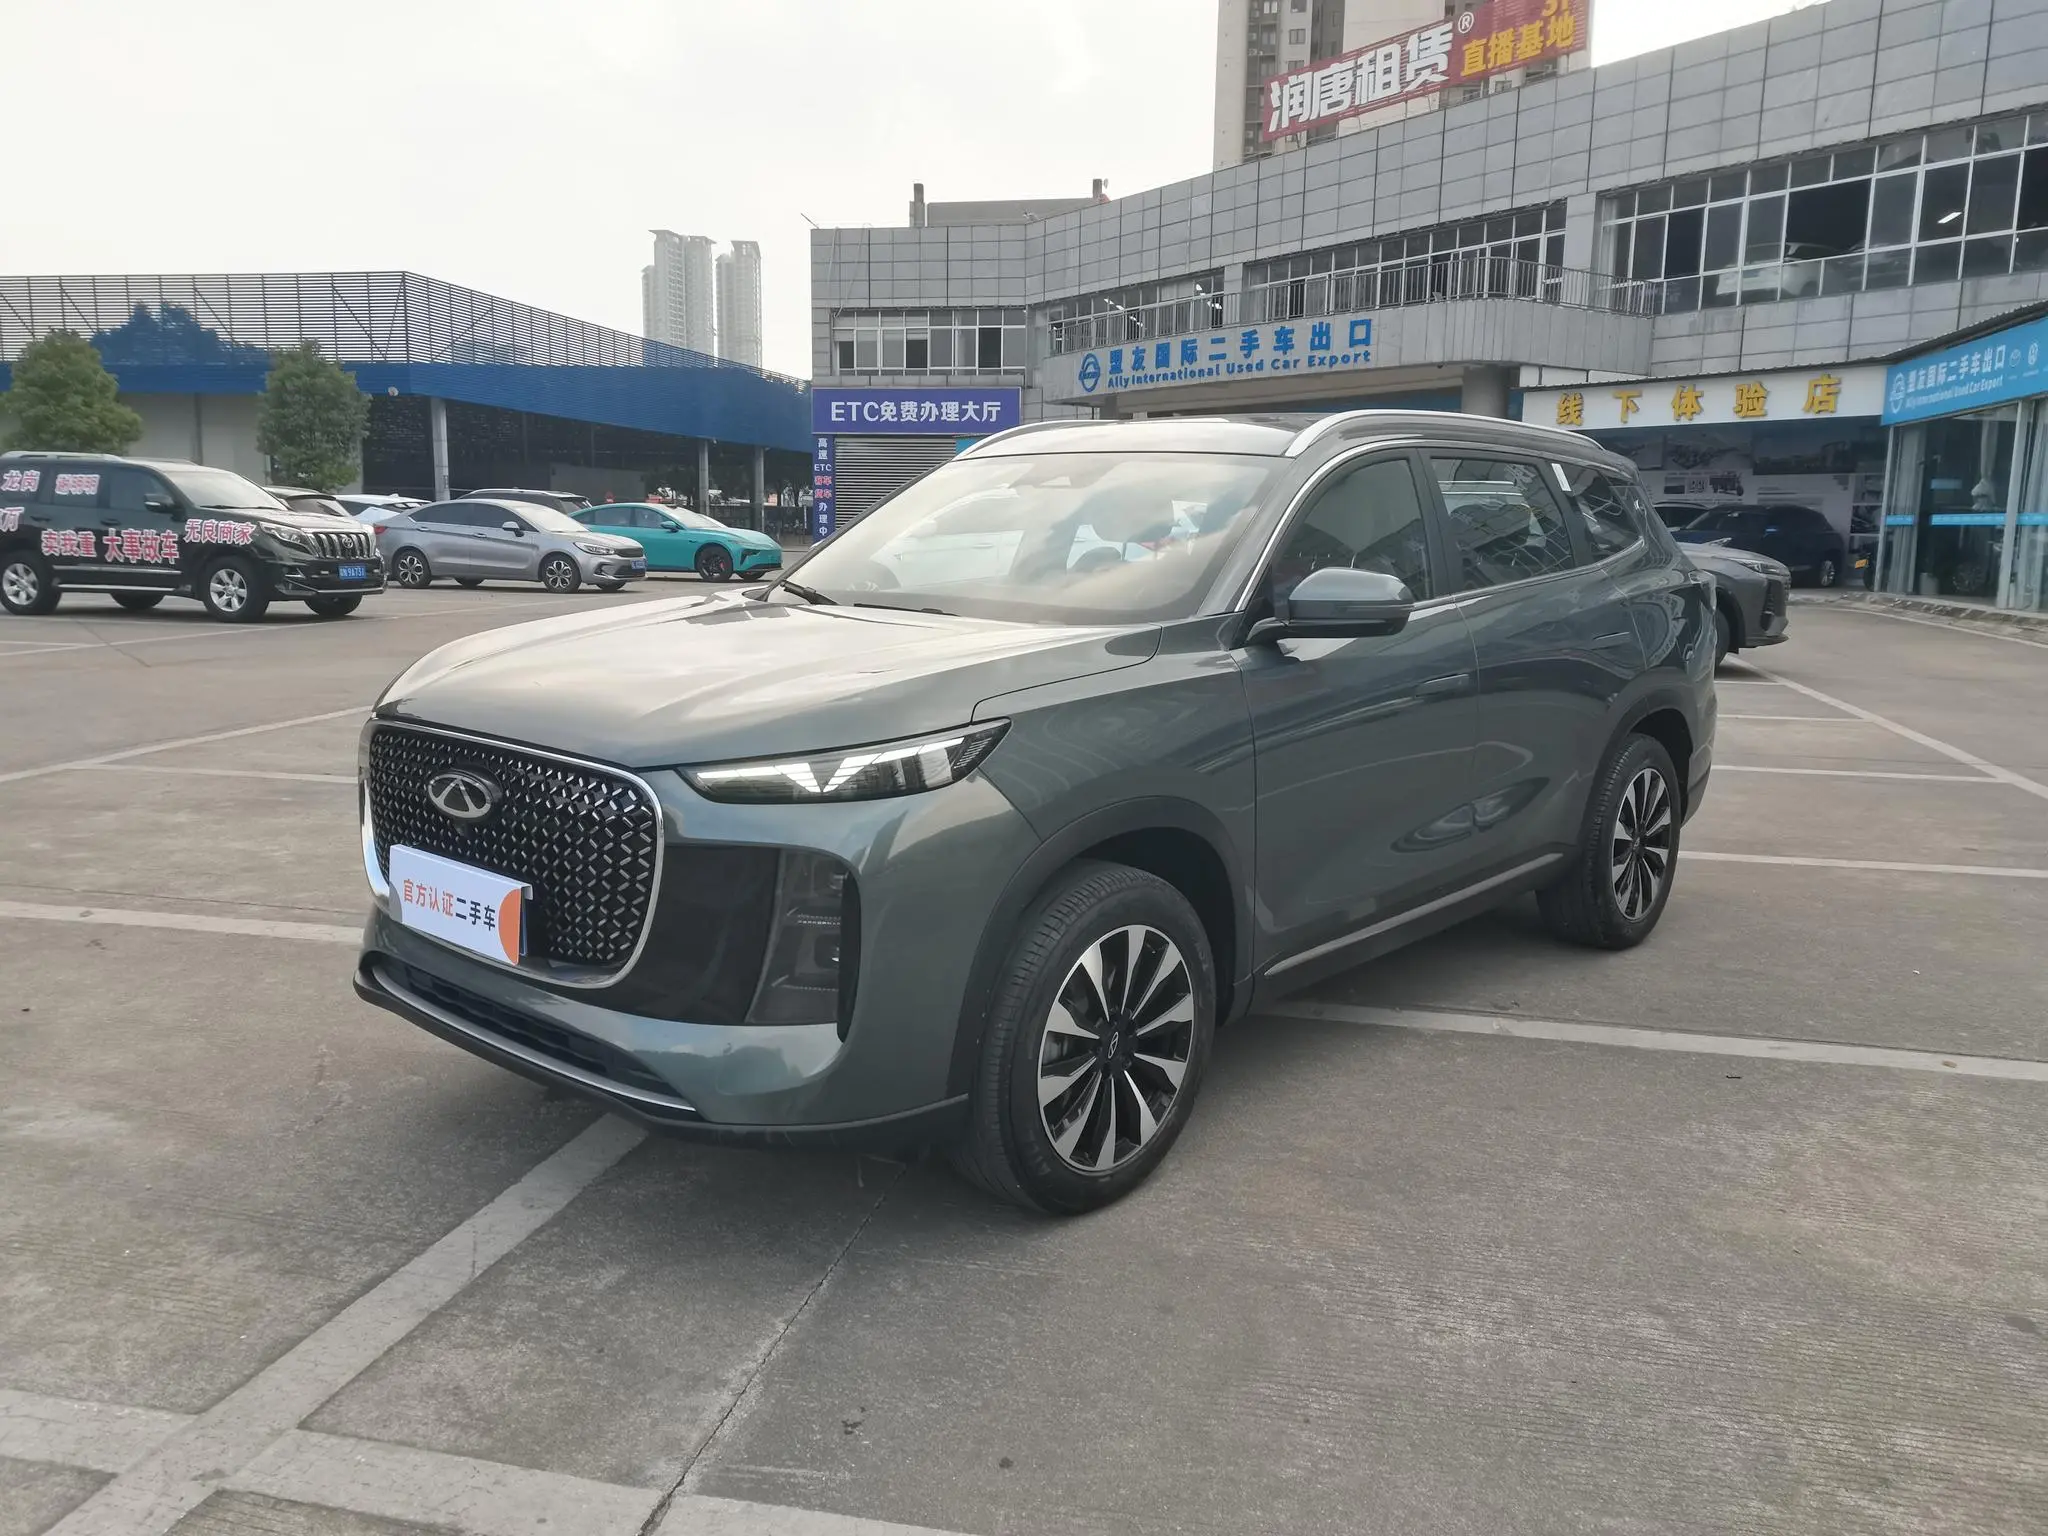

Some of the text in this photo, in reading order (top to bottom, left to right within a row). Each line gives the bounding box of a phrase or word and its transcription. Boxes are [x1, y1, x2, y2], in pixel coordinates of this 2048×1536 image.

[1461, 14, 1575, 77] 直播基地
[1268, 21, 1454, 132] 润唐租赁
[1108, 318, 1373, 375] 盟友国际二手车出口
[1226, 358, 1265, 375] Used
[1271, 356, 1301, 371] Car
[1307, 350, 1371, 369] Export
[831, 400, 1001, 422] ETC免费办理大厅
[1555, 373, 1842, 427] 线下体验店
[1, 469, 41, 492] 龙岗
[184, 518, 257, 546] 无良商家
[403, 878, 496, 932] 官方认证二手车
